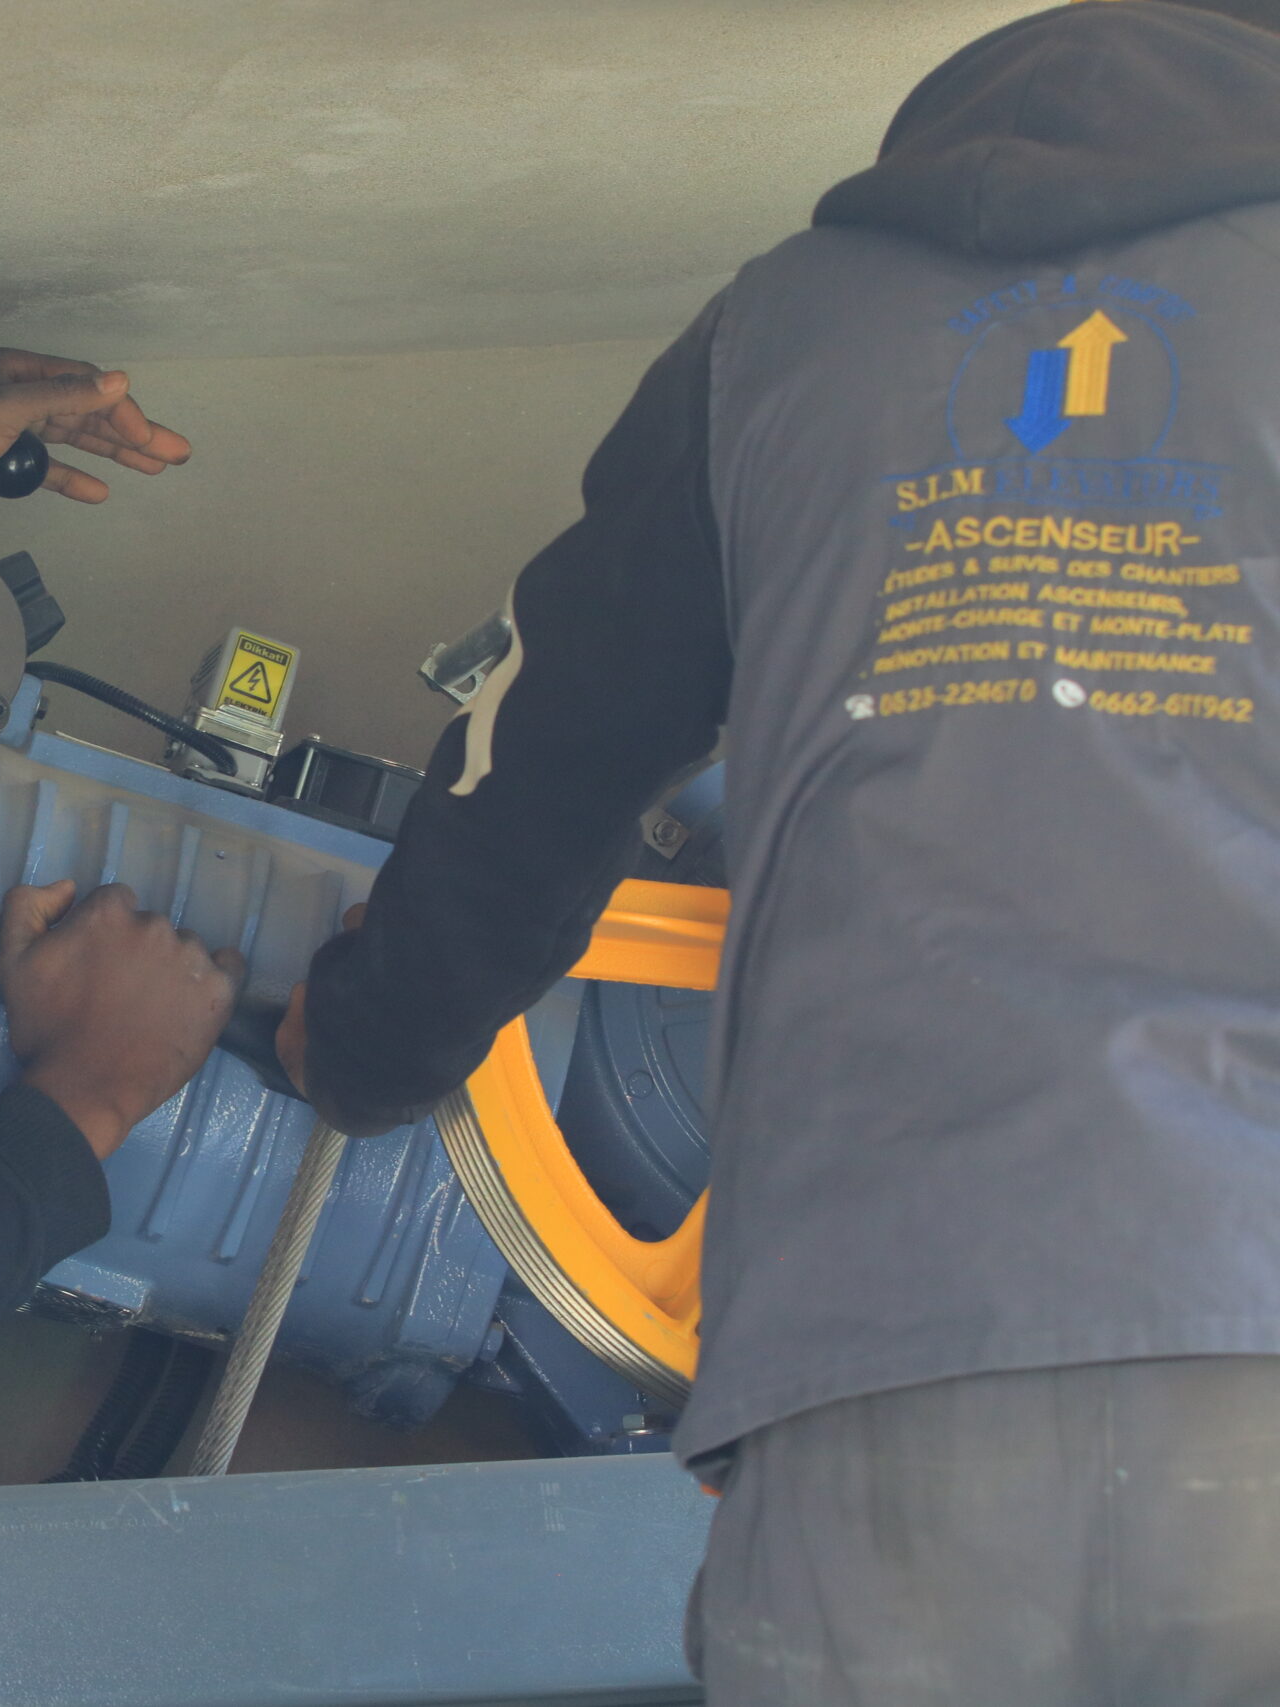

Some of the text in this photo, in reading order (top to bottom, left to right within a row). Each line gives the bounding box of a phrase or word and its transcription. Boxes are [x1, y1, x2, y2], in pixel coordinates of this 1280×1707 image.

[1065, 559, 1113, 579] DES
[1120, 561, 1241, 587] CHANTIERS
[885, 580, 1030, 623] INSTALLATION
[1052, 610, 1084, 633] ET
[242, 640, 285, 664] Dikkat!
[1016, 639, 1049, 661] ET
[1054, 643, 1217, 676] MAINTENANCE
